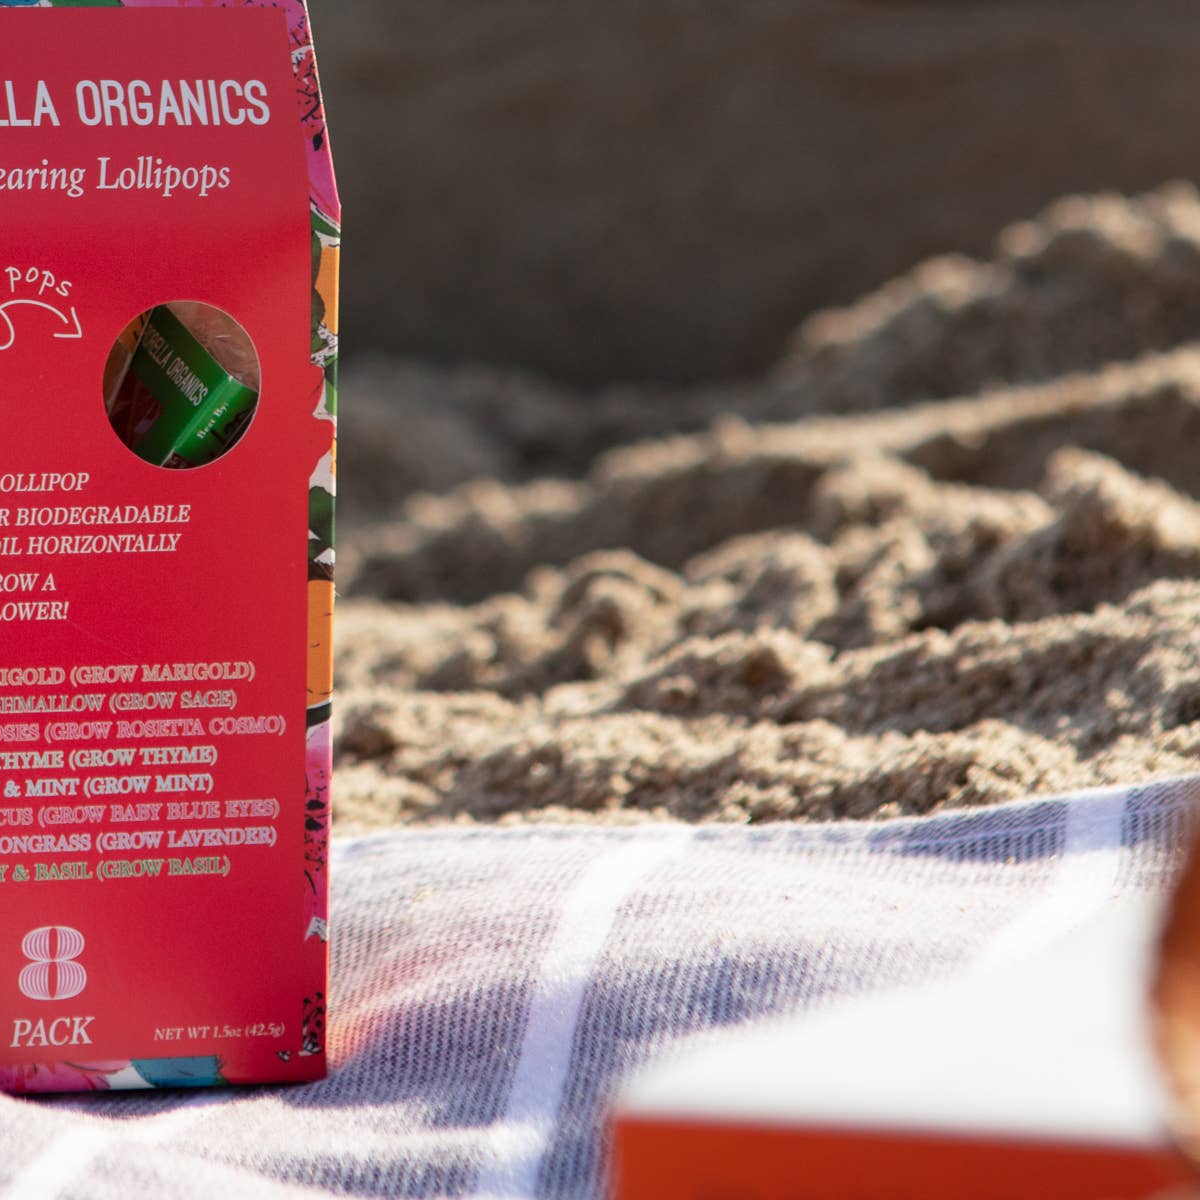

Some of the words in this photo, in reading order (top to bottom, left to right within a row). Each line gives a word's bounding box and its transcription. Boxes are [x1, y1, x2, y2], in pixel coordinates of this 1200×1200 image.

[76, 80, 270, 126] ORGANICS
[96, 156, 230, 197] Lollipops
[5, 266, 73, 297] pops
[166, 357, 209, 407] ORGANICS
[15, 505, 191, 526] BIODEGRADABLE
[26, 533, 182, 555] HORIZONTALLY
[41, 573, 56, 591] A
[70, 665, 138, 688] (GROW
[141, 661, 256, 682] MARIGOLD)
[109, 691, 177, 714] (GROW
[180, 689, 237, 710] SAGE)
[44, 721, 113, 744] (GROW
[116, 718, 206, 738] ROSETTA
[209, 715, 286, 736] COSMO)
[68, 748, 137, 771] (GROW
[139, 745, 217, 766] THYME)
[4, 780, 21, 797] &
[25, 778, 80, 797] MINT
[83, 775, 151, 798] (GROW
[155, 773, 214, 794] MINT)
[37, 805, 107, 828] (GROW
[110, 803, 163, 822] BABY
[166, 801, 221, 820] BLUE
[224, 798, 280, 819] EYES)
[96, 831, 164, 854] (GROW
[167, 826, 277, 848] LAVENDER)
[12, 864, 30, 882] &
[34, 861, 93, 881] BASIL
[96, 858, 165, 882] (GROW
[167, 855, 231, 878] BASIL)
[18, 926, 87, 1000] 8
[10, 1016, 95, 1047] PACK
[153, 1027, 185, 1041] NET
[187, 1026, 210, 1040] WT
